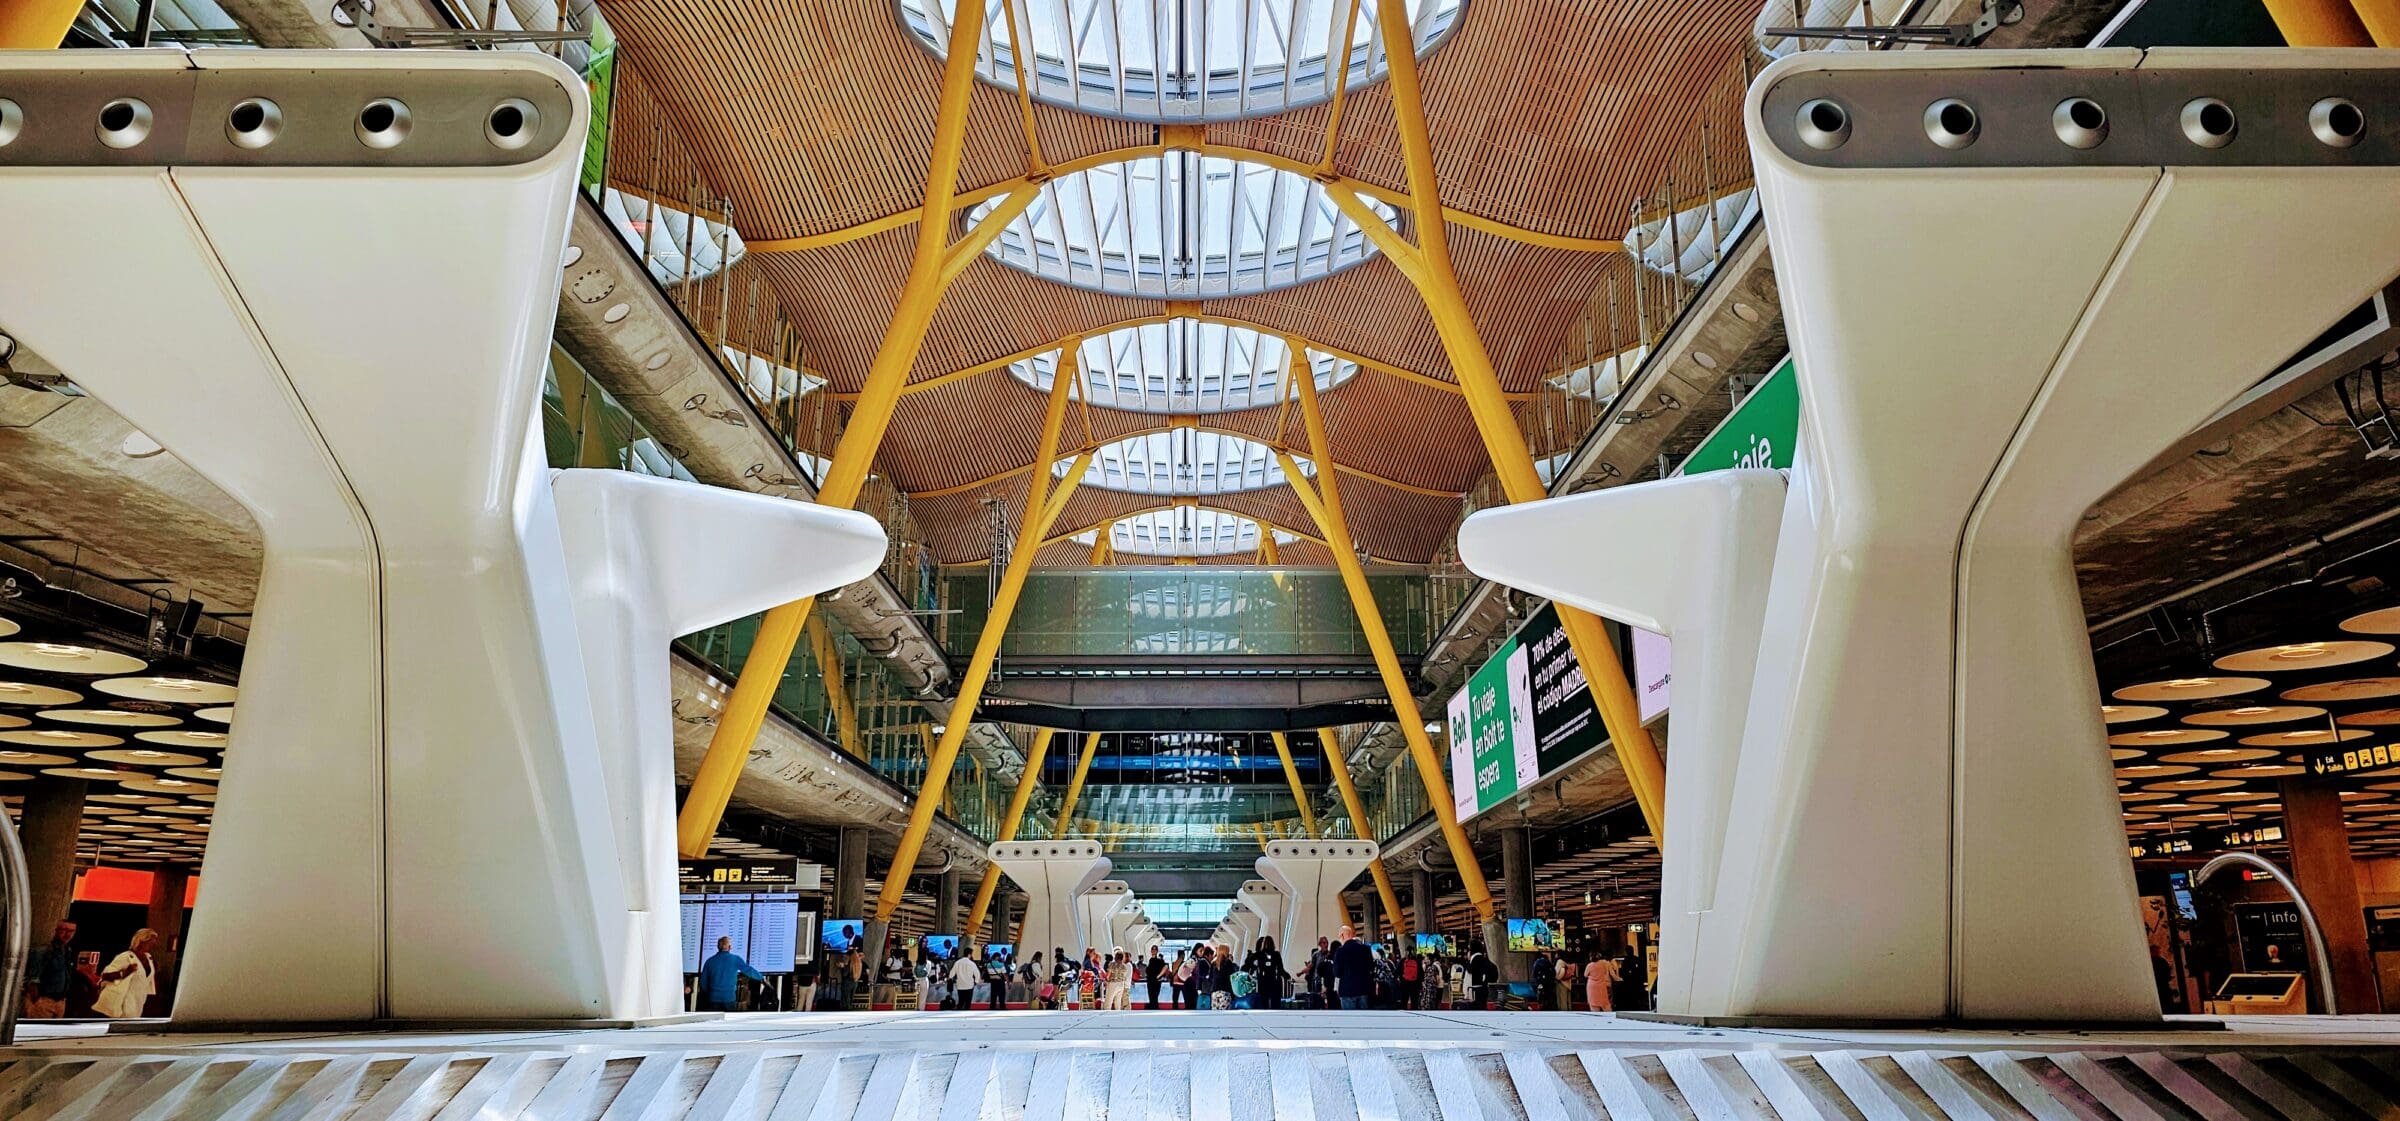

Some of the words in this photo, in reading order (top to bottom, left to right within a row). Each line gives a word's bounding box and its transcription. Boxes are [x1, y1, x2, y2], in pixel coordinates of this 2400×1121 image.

[1532, 639, 1545, 665] 70%
[1545, 634, 1553, 654] de
[1535, 672, 1543, 690] en
[1541, 666, 1549, 684] tu
[1548, 651, 1567, 684] primer
[1472, 696, 1481, 722] Tu
[1481, 682, 1496, 716] viaje
[1537, 695, 1543, 715] el
[1453, 710, 1467, 748] Bolt
[1476, 738, 1484, 758] en
[1484, 720, 1497, 753] Bolt
[1496, 718, 1505, 743] te
[1478, 759, 1500, 795] espera
[2271, 911, 2298, 923] info
